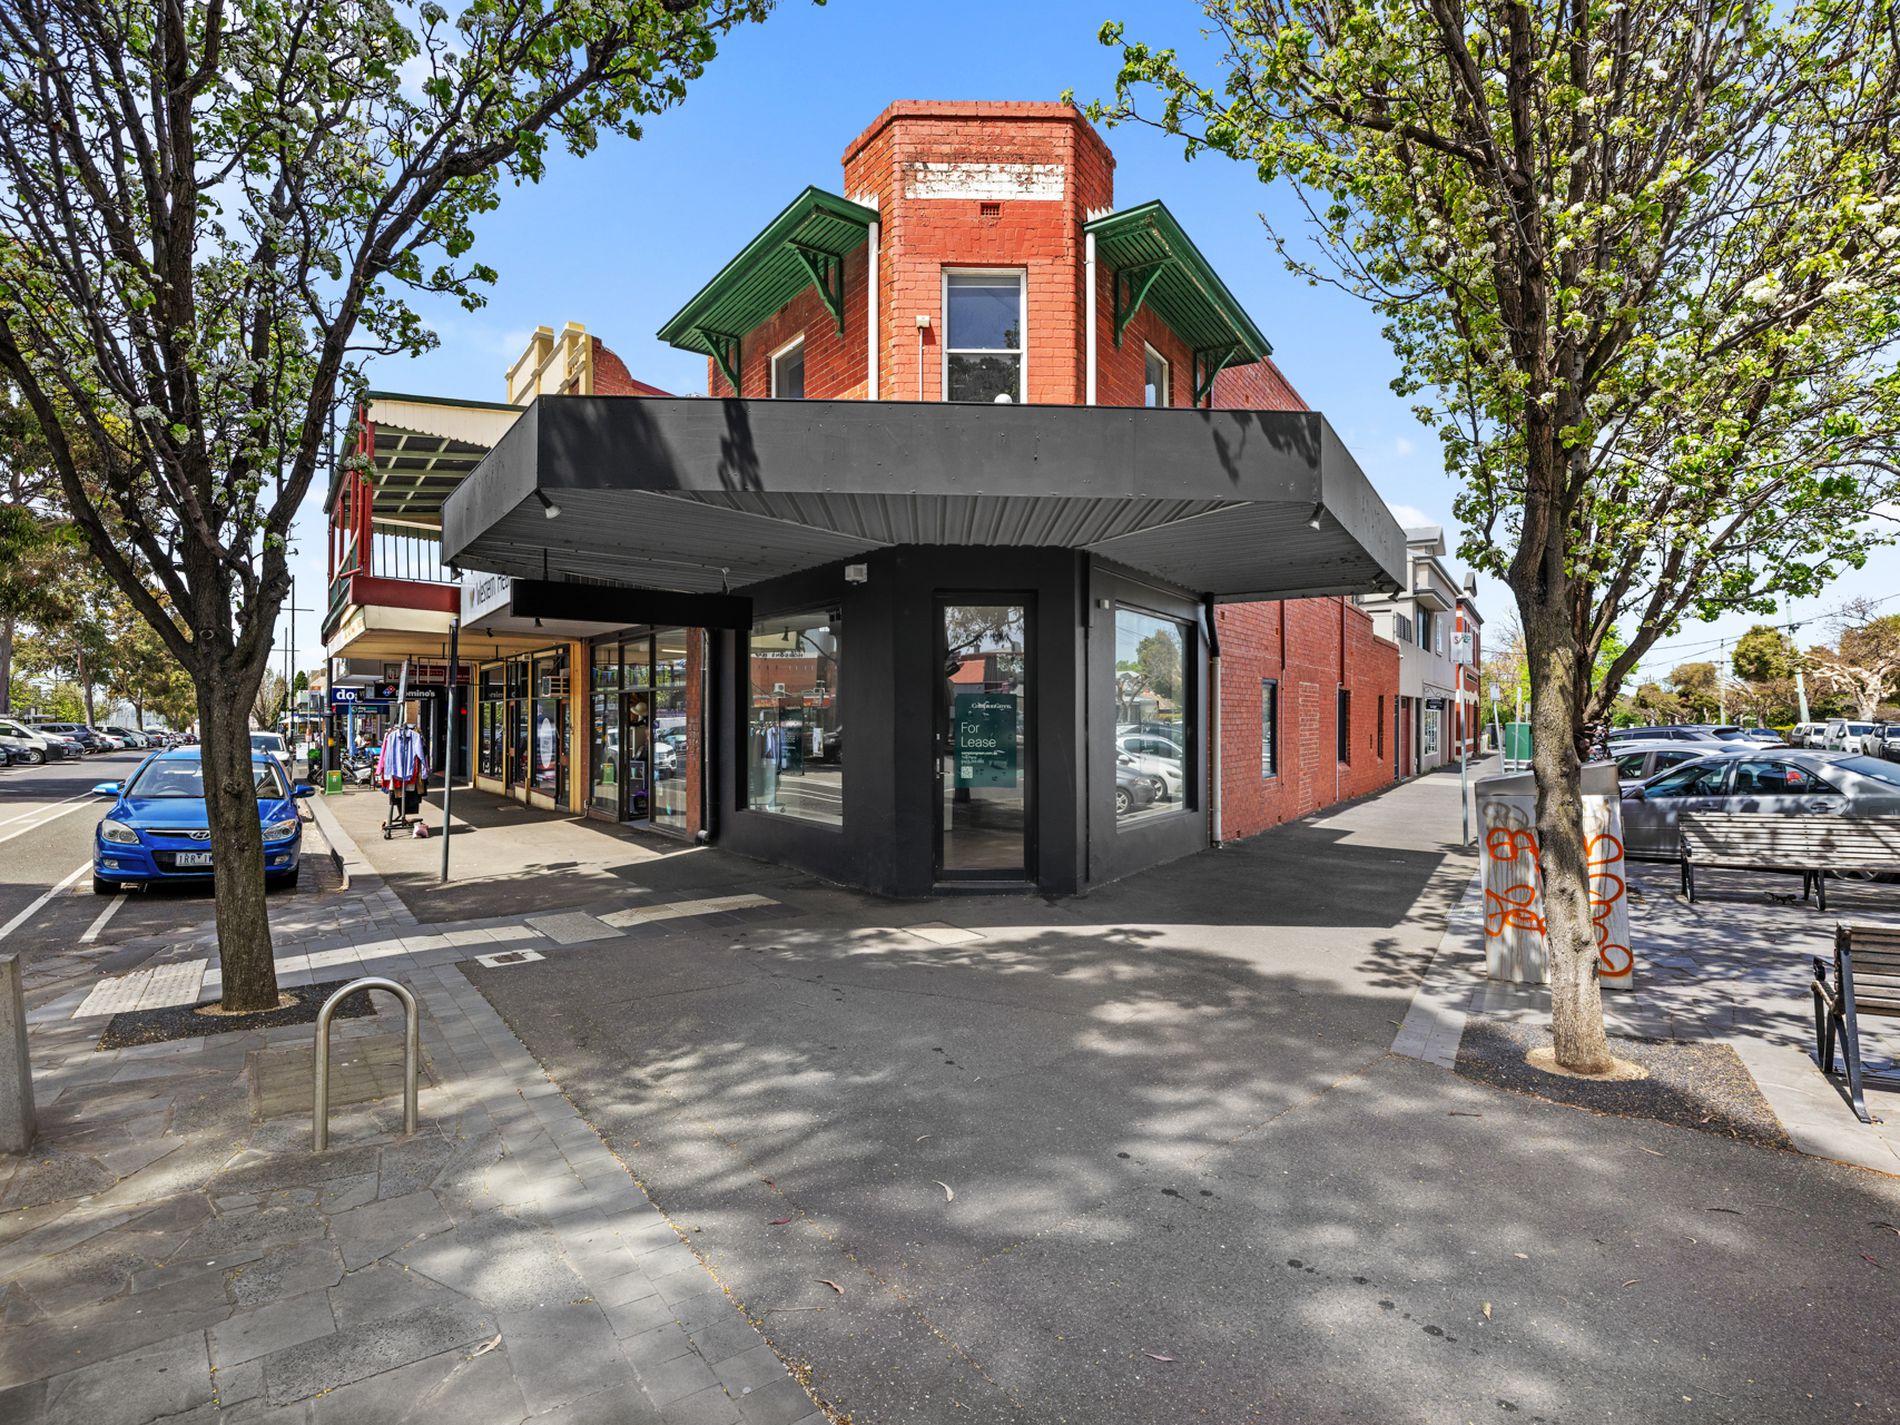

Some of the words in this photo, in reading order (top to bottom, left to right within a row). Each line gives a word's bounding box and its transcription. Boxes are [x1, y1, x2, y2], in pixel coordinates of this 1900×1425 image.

[476, 576, 496, 606] Western
[336, 689, 362, 703] do
[961, 722, 980, 733] For
[961, 736, 997, 748] Lease
